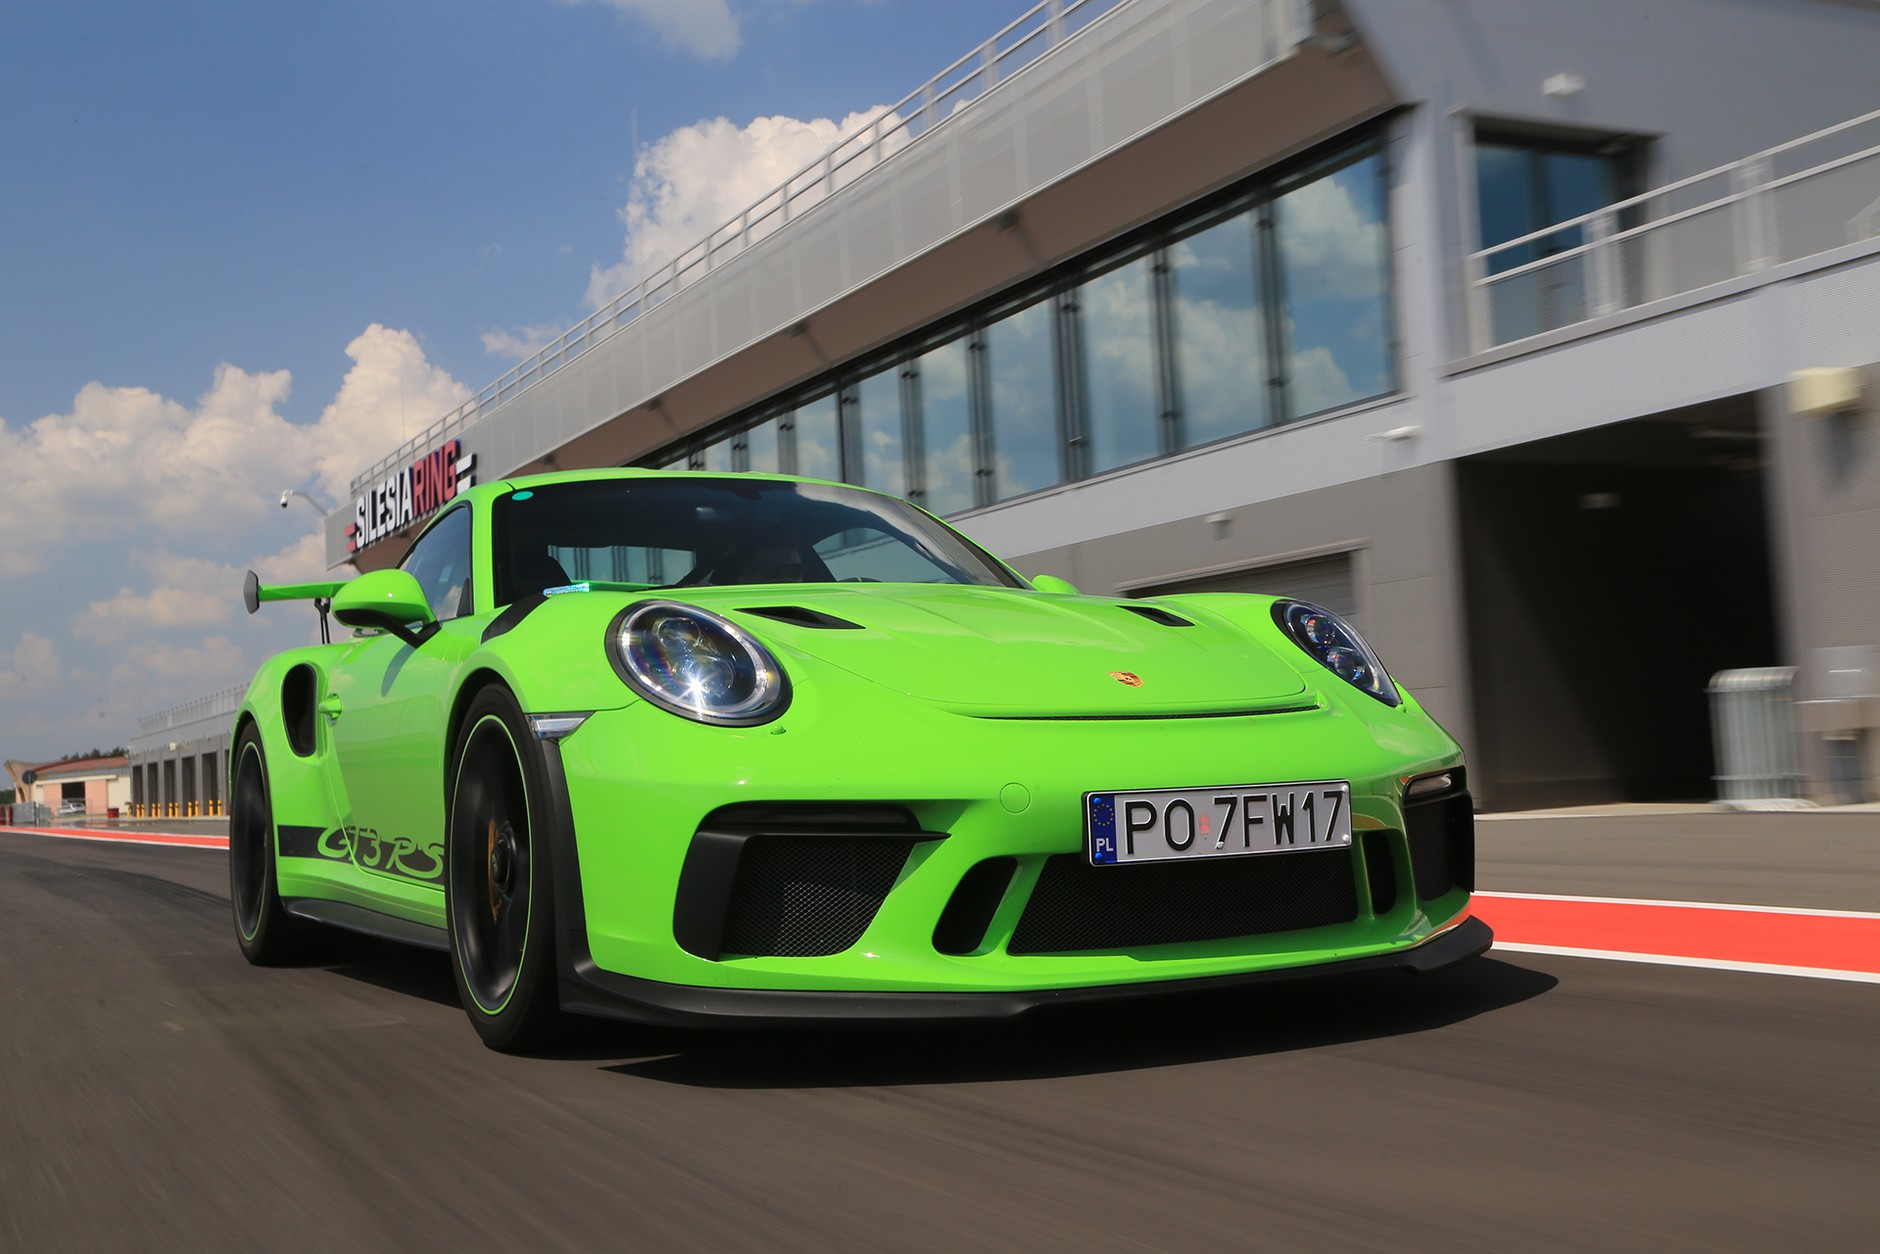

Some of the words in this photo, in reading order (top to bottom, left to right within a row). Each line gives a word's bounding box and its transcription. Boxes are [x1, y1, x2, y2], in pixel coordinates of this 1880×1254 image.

[1095, 837, 1114, 852] PL
[1124, 798, 1196, 855] PO
[1213, 790, 1344, 849] 7FW17
[316, 825, 382, 867] GT3
[384, 836, 445, 879] RS
